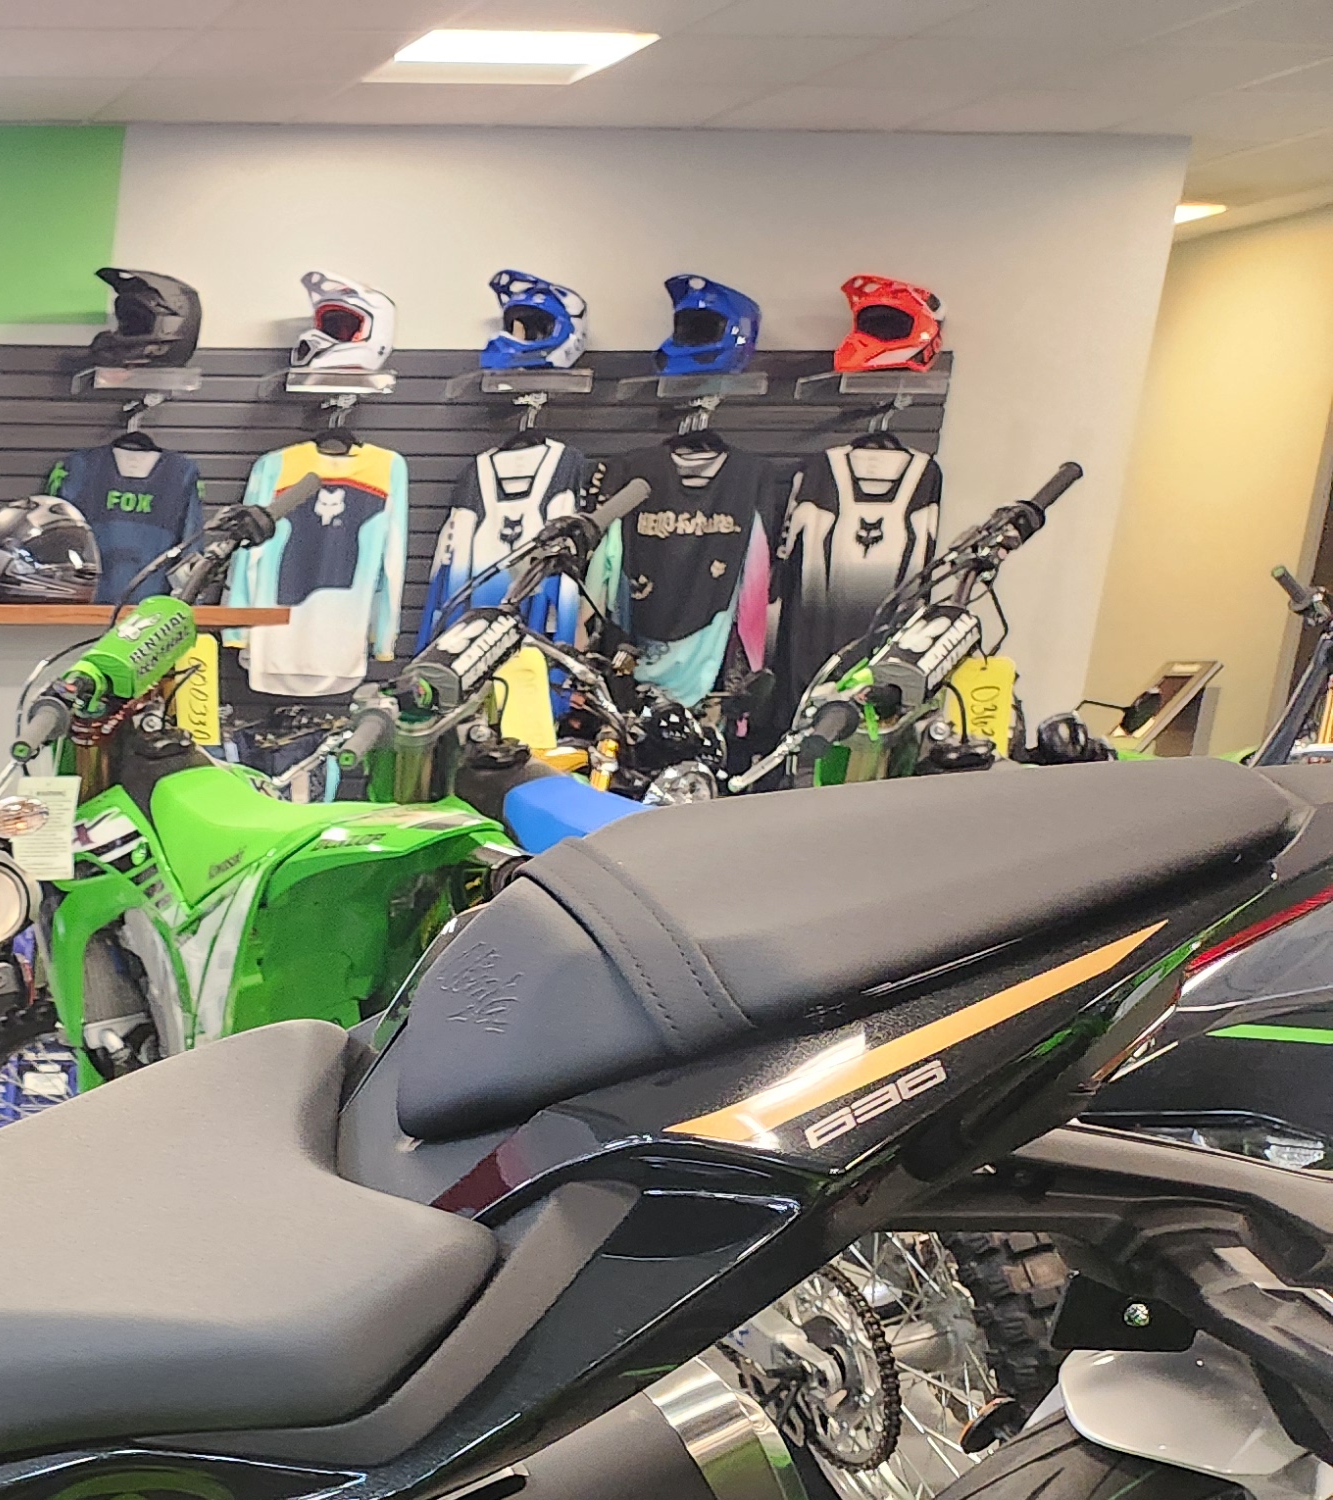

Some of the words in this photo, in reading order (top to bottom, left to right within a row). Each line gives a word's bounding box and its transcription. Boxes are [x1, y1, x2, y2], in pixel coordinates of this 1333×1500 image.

[106, 488, 155, 514] FOX
[129, 611, 188, 664] RENTHAL
[916, 611, 980, 676] RENTHAL
[804, 1058, 948, 1150] 636
